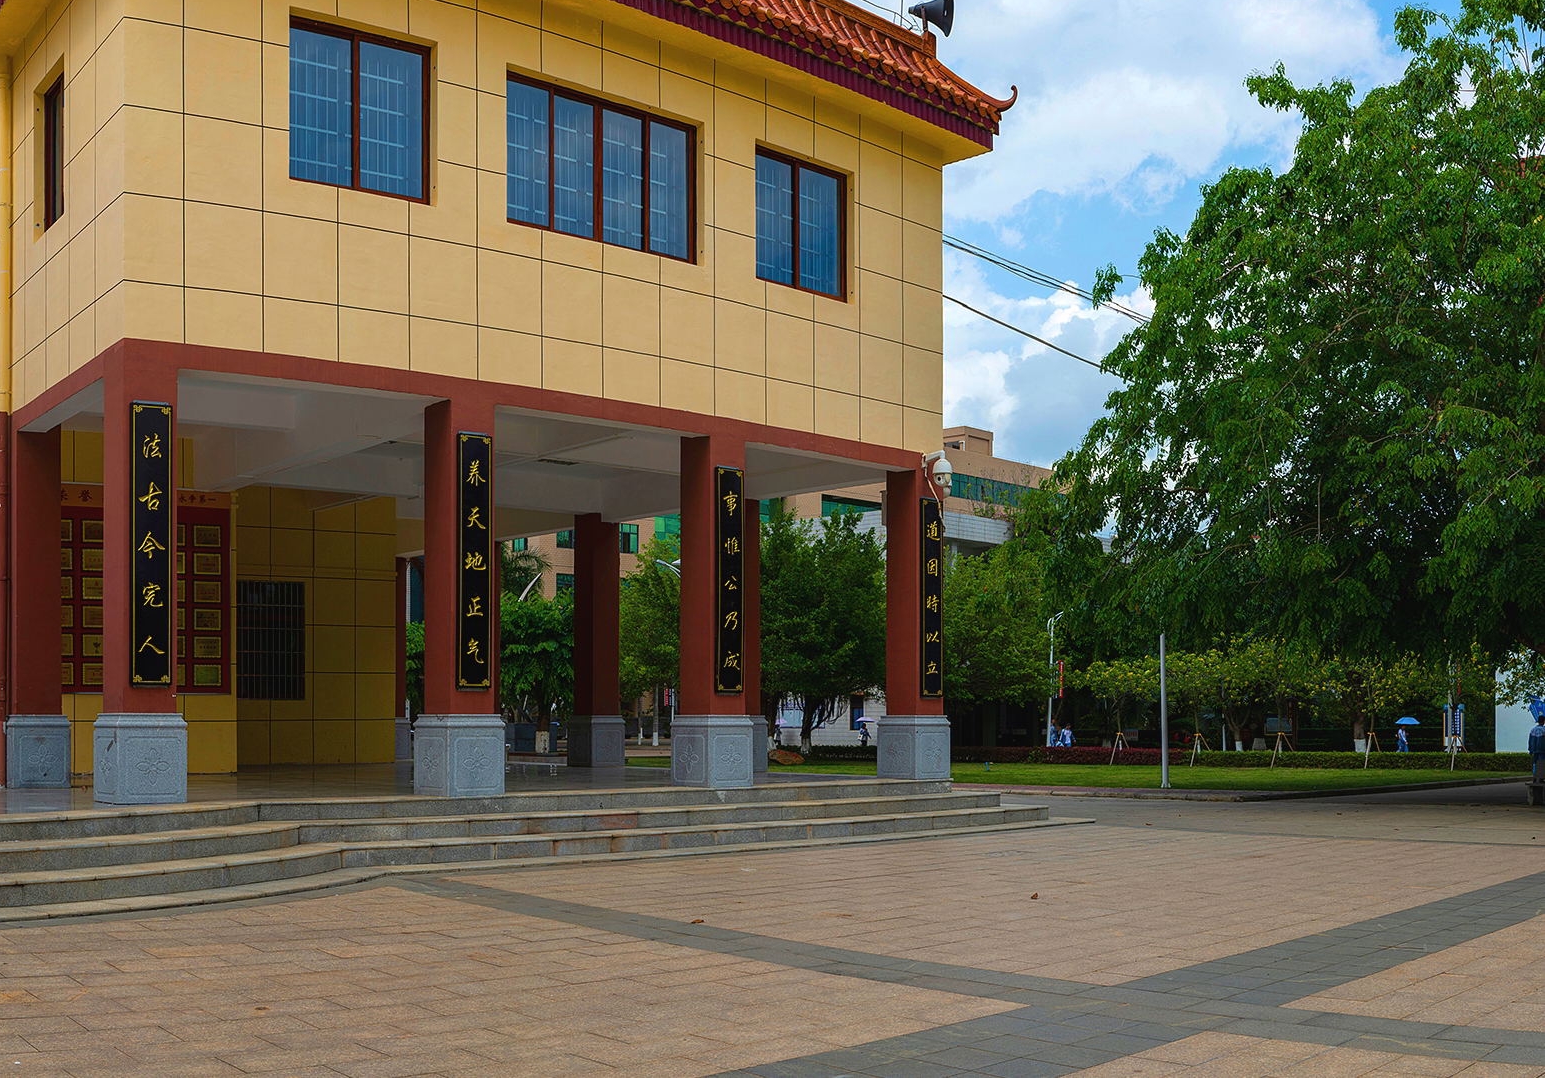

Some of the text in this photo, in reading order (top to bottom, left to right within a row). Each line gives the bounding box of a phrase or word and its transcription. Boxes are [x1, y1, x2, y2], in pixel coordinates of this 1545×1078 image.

[137, 433, 166, 656] 法古今完人
[464, 459, 487, 666] 养天地正气
[723, 490, 741, 672] 事惟公乃成
